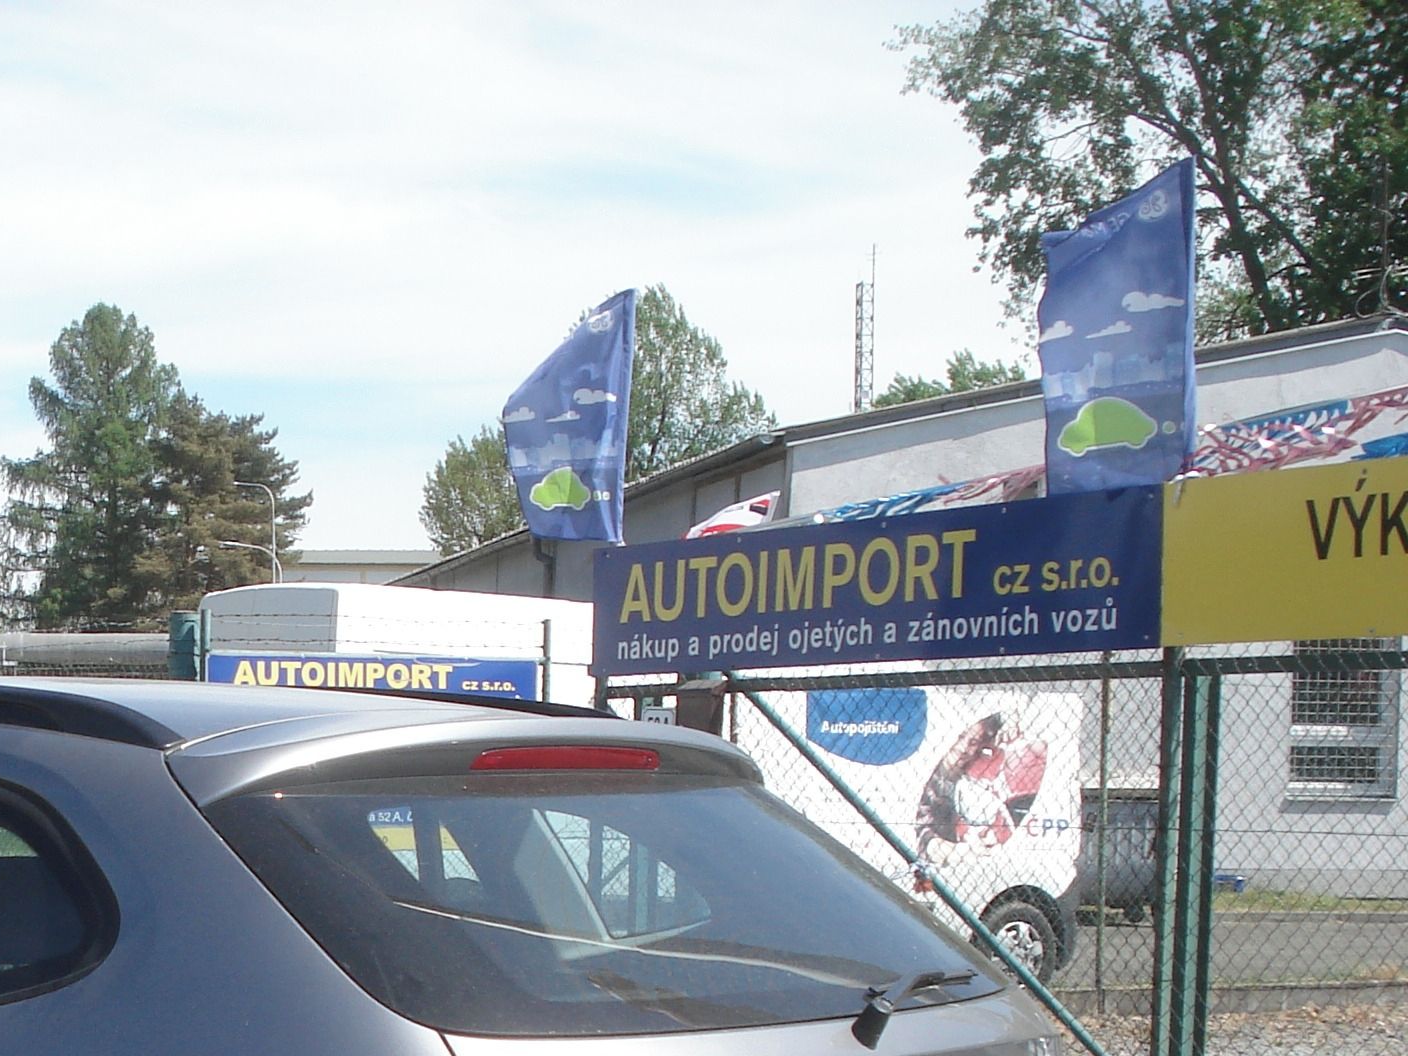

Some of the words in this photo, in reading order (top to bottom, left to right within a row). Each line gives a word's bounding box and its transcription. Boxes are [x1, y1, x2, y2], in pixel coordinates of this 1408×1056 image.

[619, 528, 977, 624] AUTOIMPORT
[993, 564, 1031, 595] cz
[1042, 557, 1120, 592] s.r.o.
[617, 633, 680, 662] nákup
[688, 636, 699, 656] a
[709, 624, 779, 660] prodej
[788, 617, 873, 653] ojetých
[883, 622, 897, 643] a
[908, 605, 1039, 643] zánovních
[1051, 597, 1118, 633] vozů
[233, 660, 453, 690] AUTOIMPORT
[462, 680, 479, 691] cz
[481, 680, 516, 692] s.r.o.
[1026, 814, 1069, 838] ČPP
